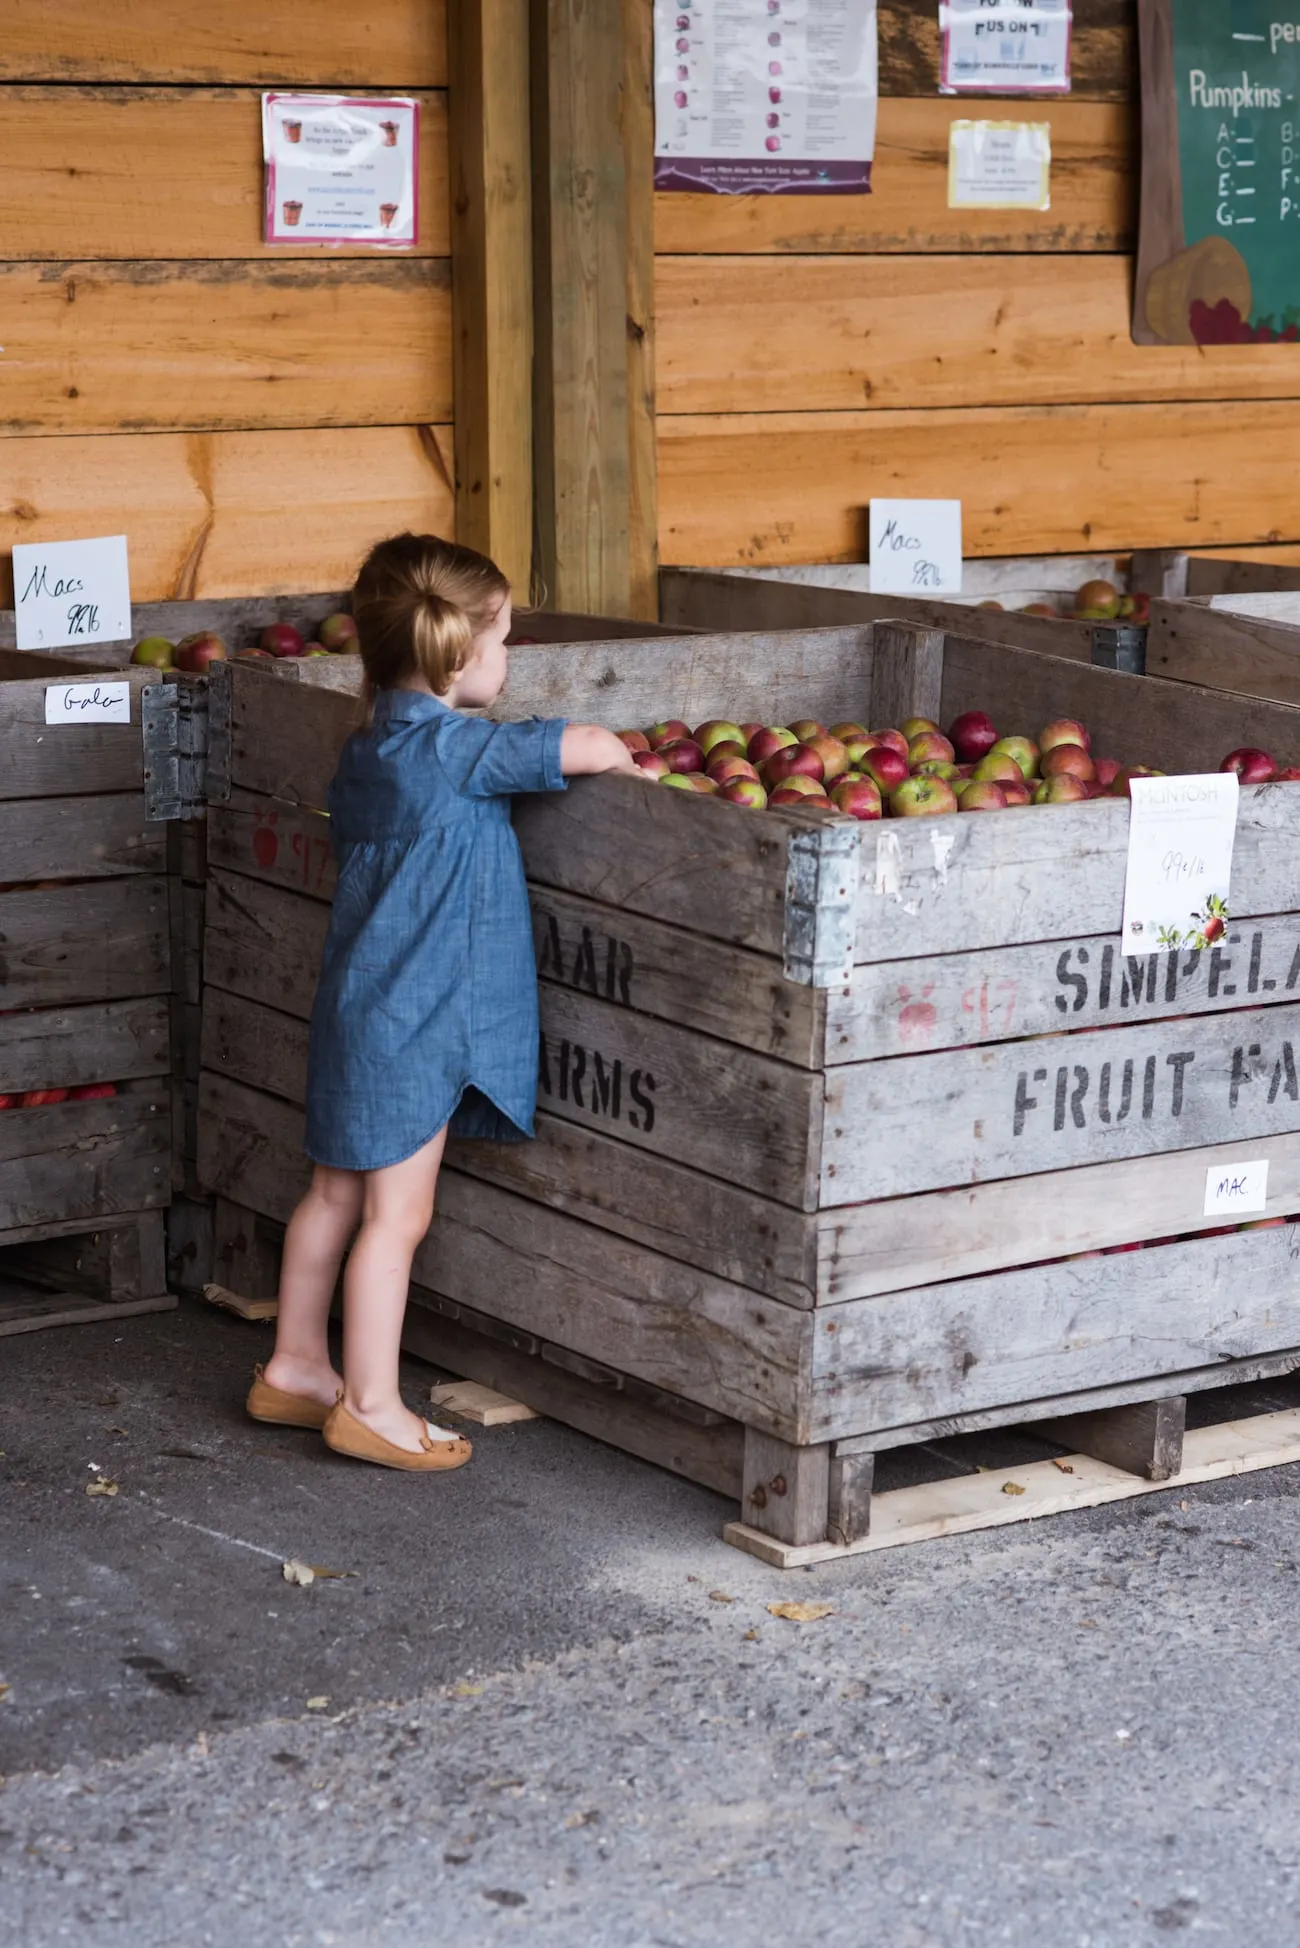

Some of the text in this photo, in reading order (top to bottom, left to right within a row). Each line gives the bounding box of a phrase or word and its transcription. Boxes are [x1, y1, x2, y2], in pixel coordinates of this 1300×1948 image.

[986, 20, 1027, 33] US ON
[1189, 69, 1282, 118] Pumpkins
[21, 565, 84, 603] Macs
[64, 687, 124, 711] Gala
[1013, 1051, 1195, 1136] FRUIT
